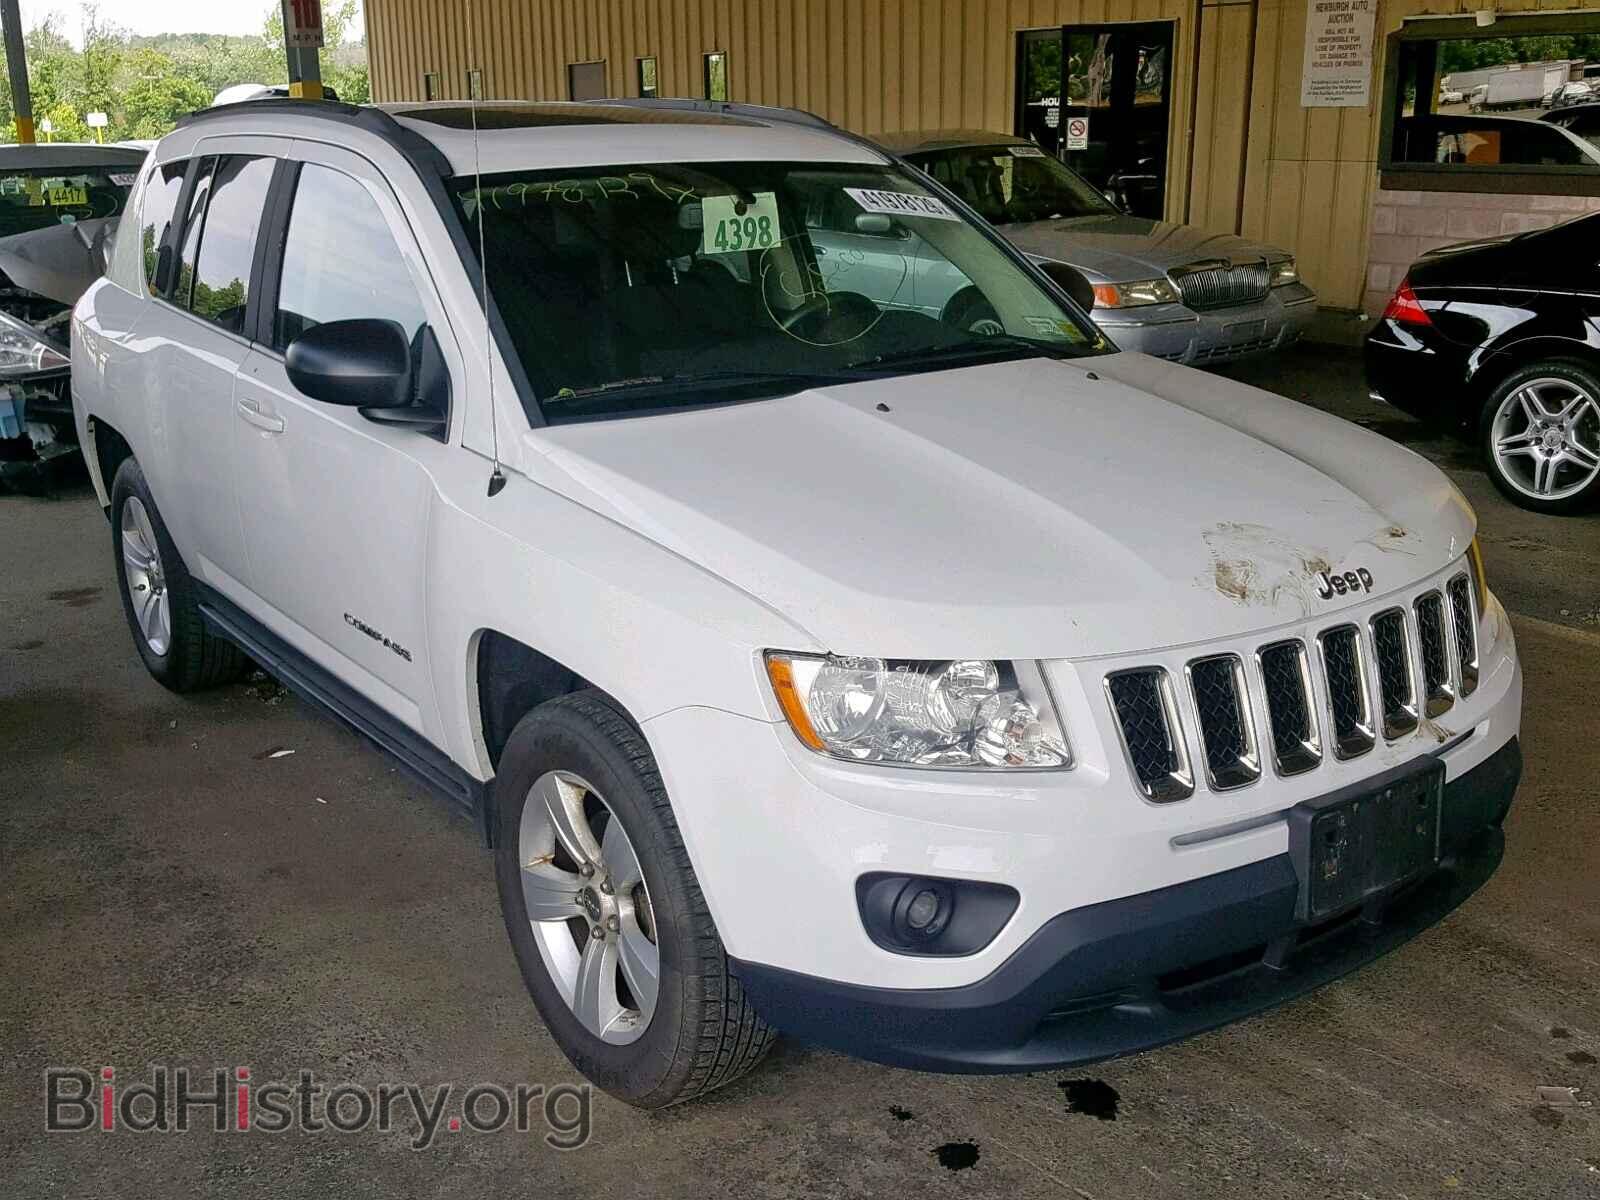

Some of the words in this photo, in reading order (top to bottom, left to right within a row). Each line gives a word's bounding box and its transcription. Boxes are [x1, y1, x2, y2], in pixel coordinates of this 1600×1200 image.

[1316, 1, 1349, 13] NEWBURGH
[1352, 0, 1368, 10] AUTO
[1328, 13, 1354, 24] AUCTION
[1041, 97, 1073, 106] HOUS
[53, 188, 82, 203] 4417
[714, 215, 772, 251] 4398
[1315, 567, 1374, 600] Jeep
[344, 613, 412, 662] COMPASS
